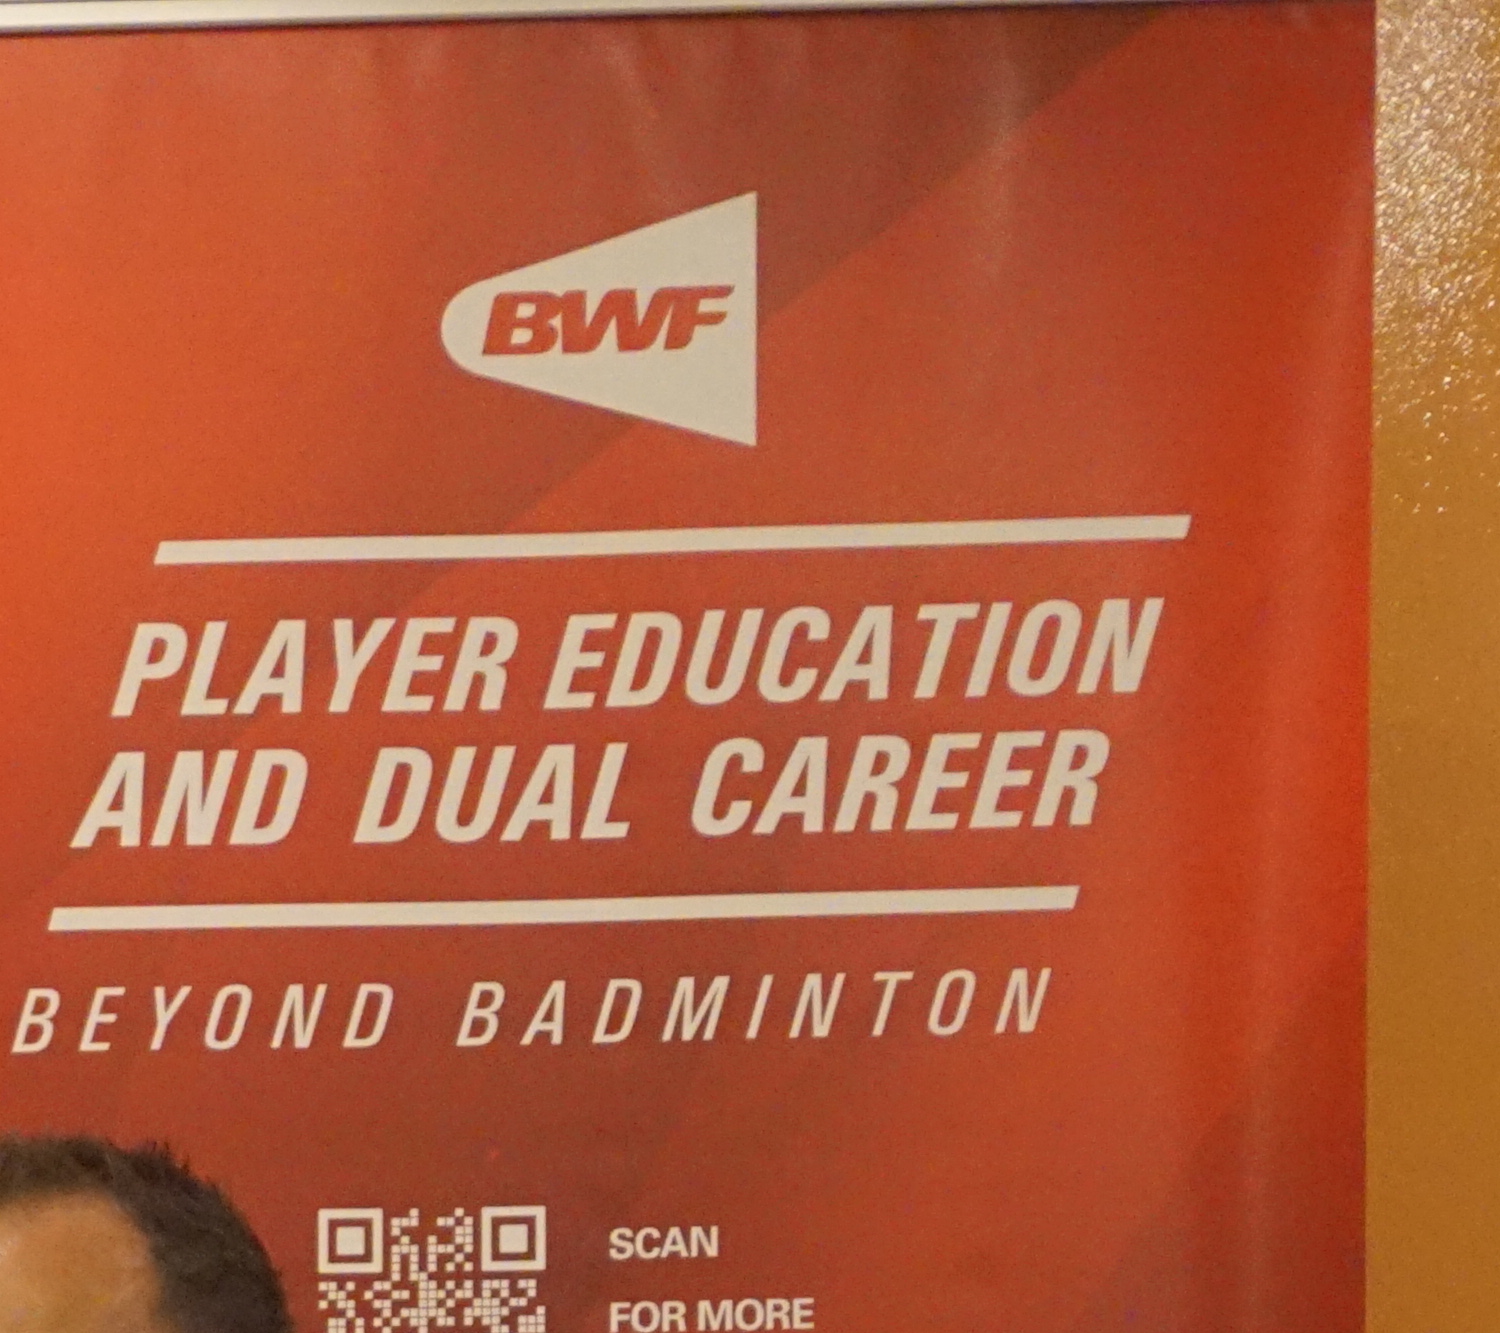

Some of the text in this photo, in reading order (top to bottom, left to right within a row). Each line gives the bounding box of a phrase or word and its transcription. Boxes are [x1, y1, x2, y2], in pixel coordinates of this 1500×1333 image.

[481, 284, 736, 357] BWF
[110, 597, 1166, 717] PLAYER EDUCATION
[68, 728, 1110, 849] AND DUAL CAREER
[10, 966, 1053, 1054] BEYOND BADMINTON
[608, 1225, 720, 1261] SCAN
[608, 1297, 816, 1333] FOR MORE
